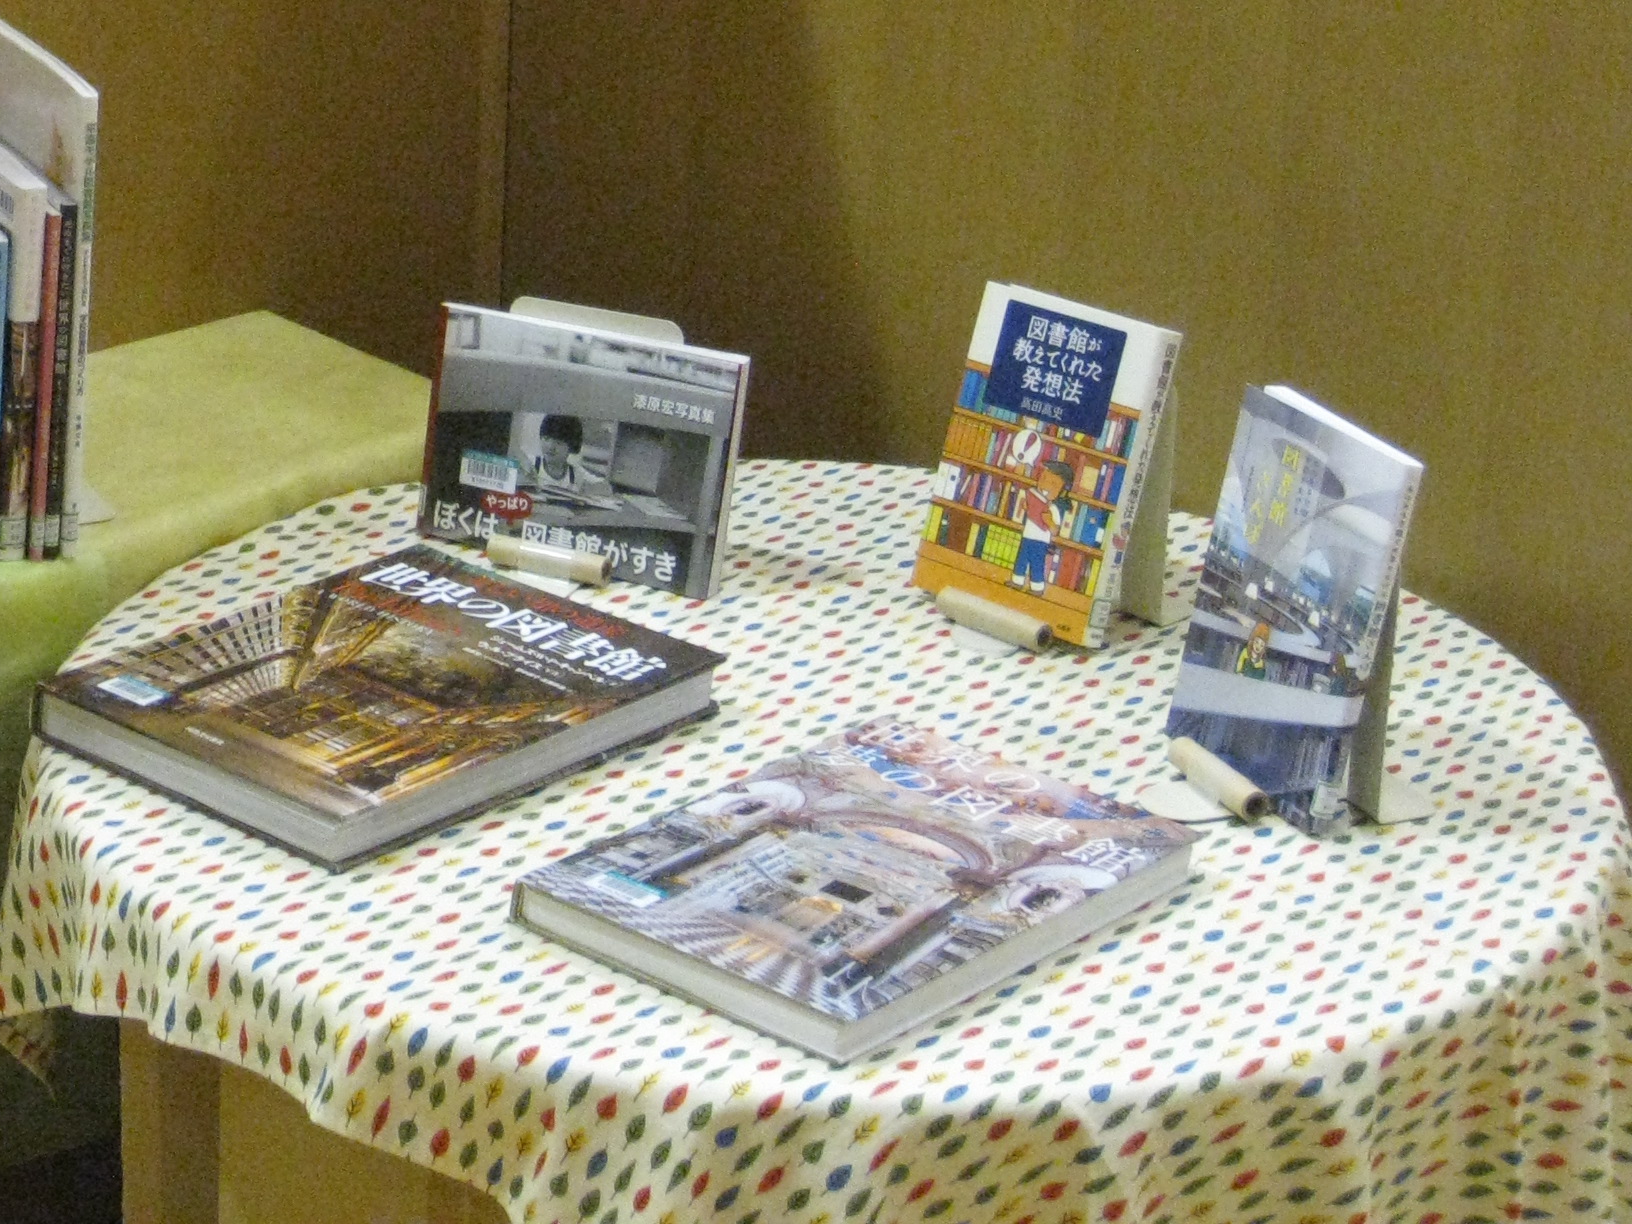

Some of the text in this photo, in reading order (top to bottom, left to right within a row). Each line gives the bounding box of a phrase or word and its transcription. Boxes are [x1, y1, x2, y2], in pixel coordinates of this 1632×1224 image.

[1026, 314, 1103, 355] 図書館が
[1012, 338, 1103, 382] 教えてくれた
[1021, 367, 1083, 405] 発想法
[433, 498, 499, 539] ぼくは
[486, 495, 528, 511] やっぱり
[359, 562, 667, 681] 世界の図書館
